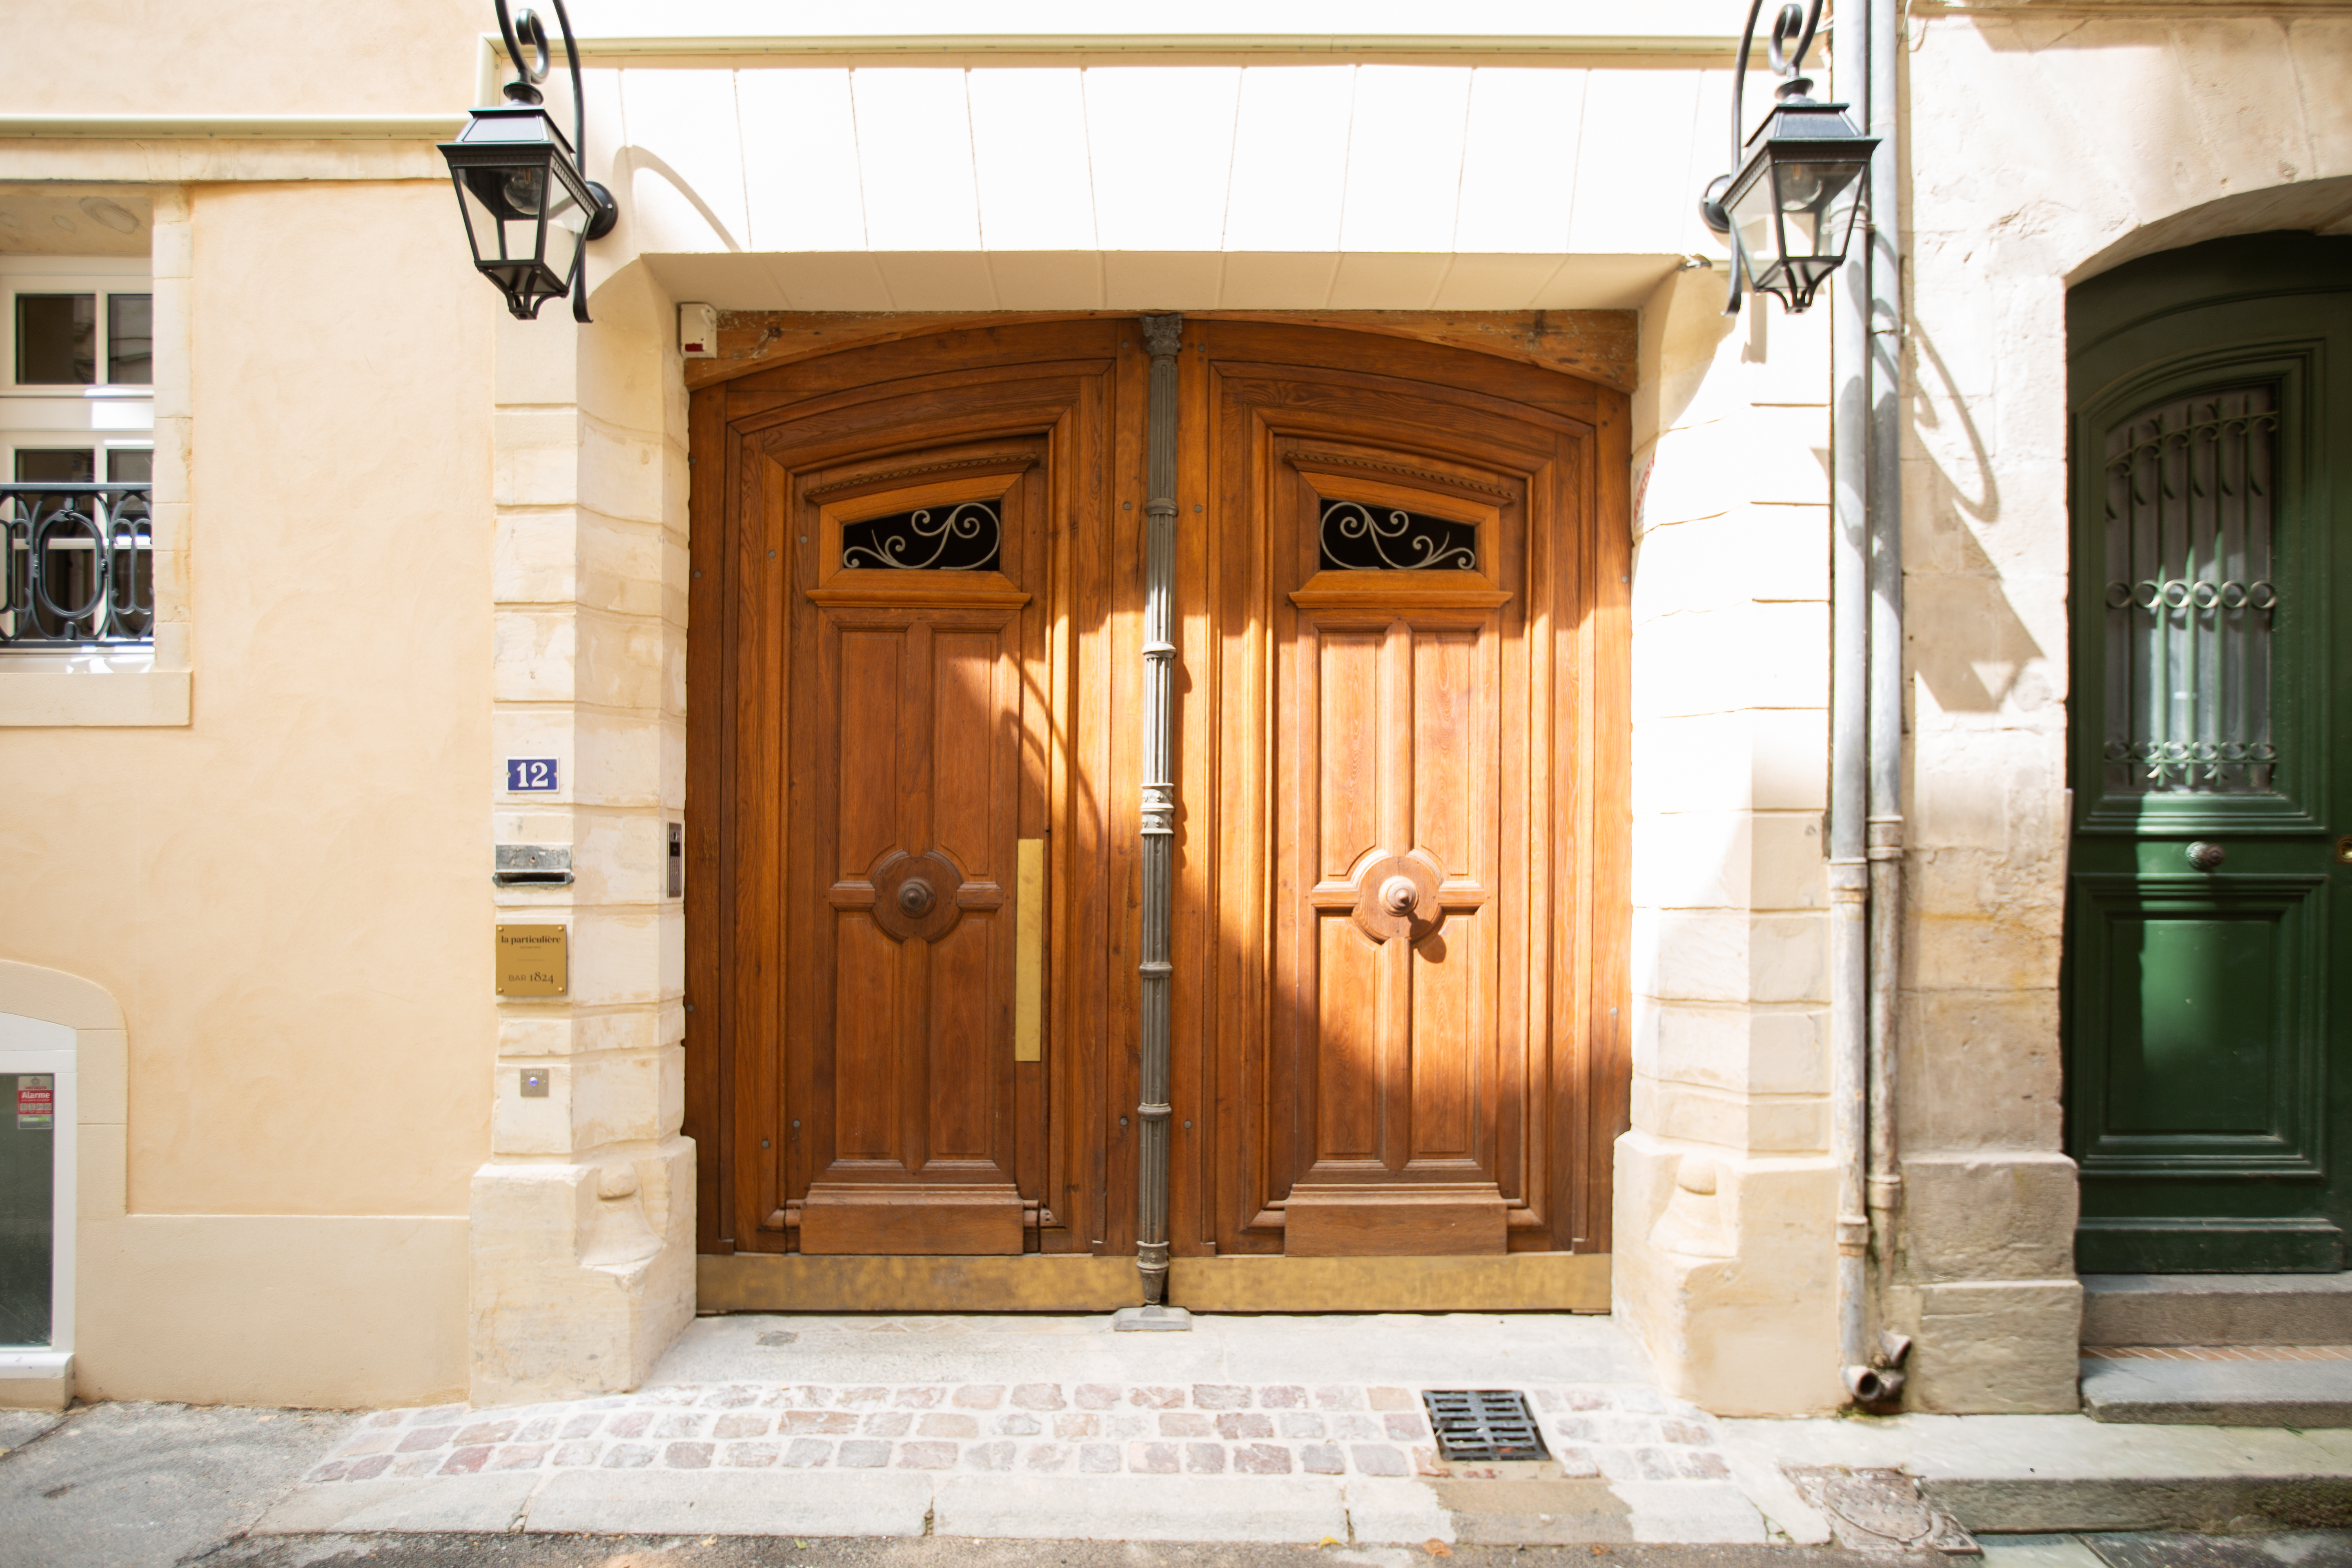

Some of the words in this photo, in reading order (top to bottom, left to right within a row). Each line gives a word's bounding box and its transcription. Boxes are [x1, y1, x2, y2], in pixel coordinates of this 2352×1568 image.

[517, 762, 548, 788] 12
[511, 935, 561, 945] particulière
[530, 971, 553, 984] 1824
